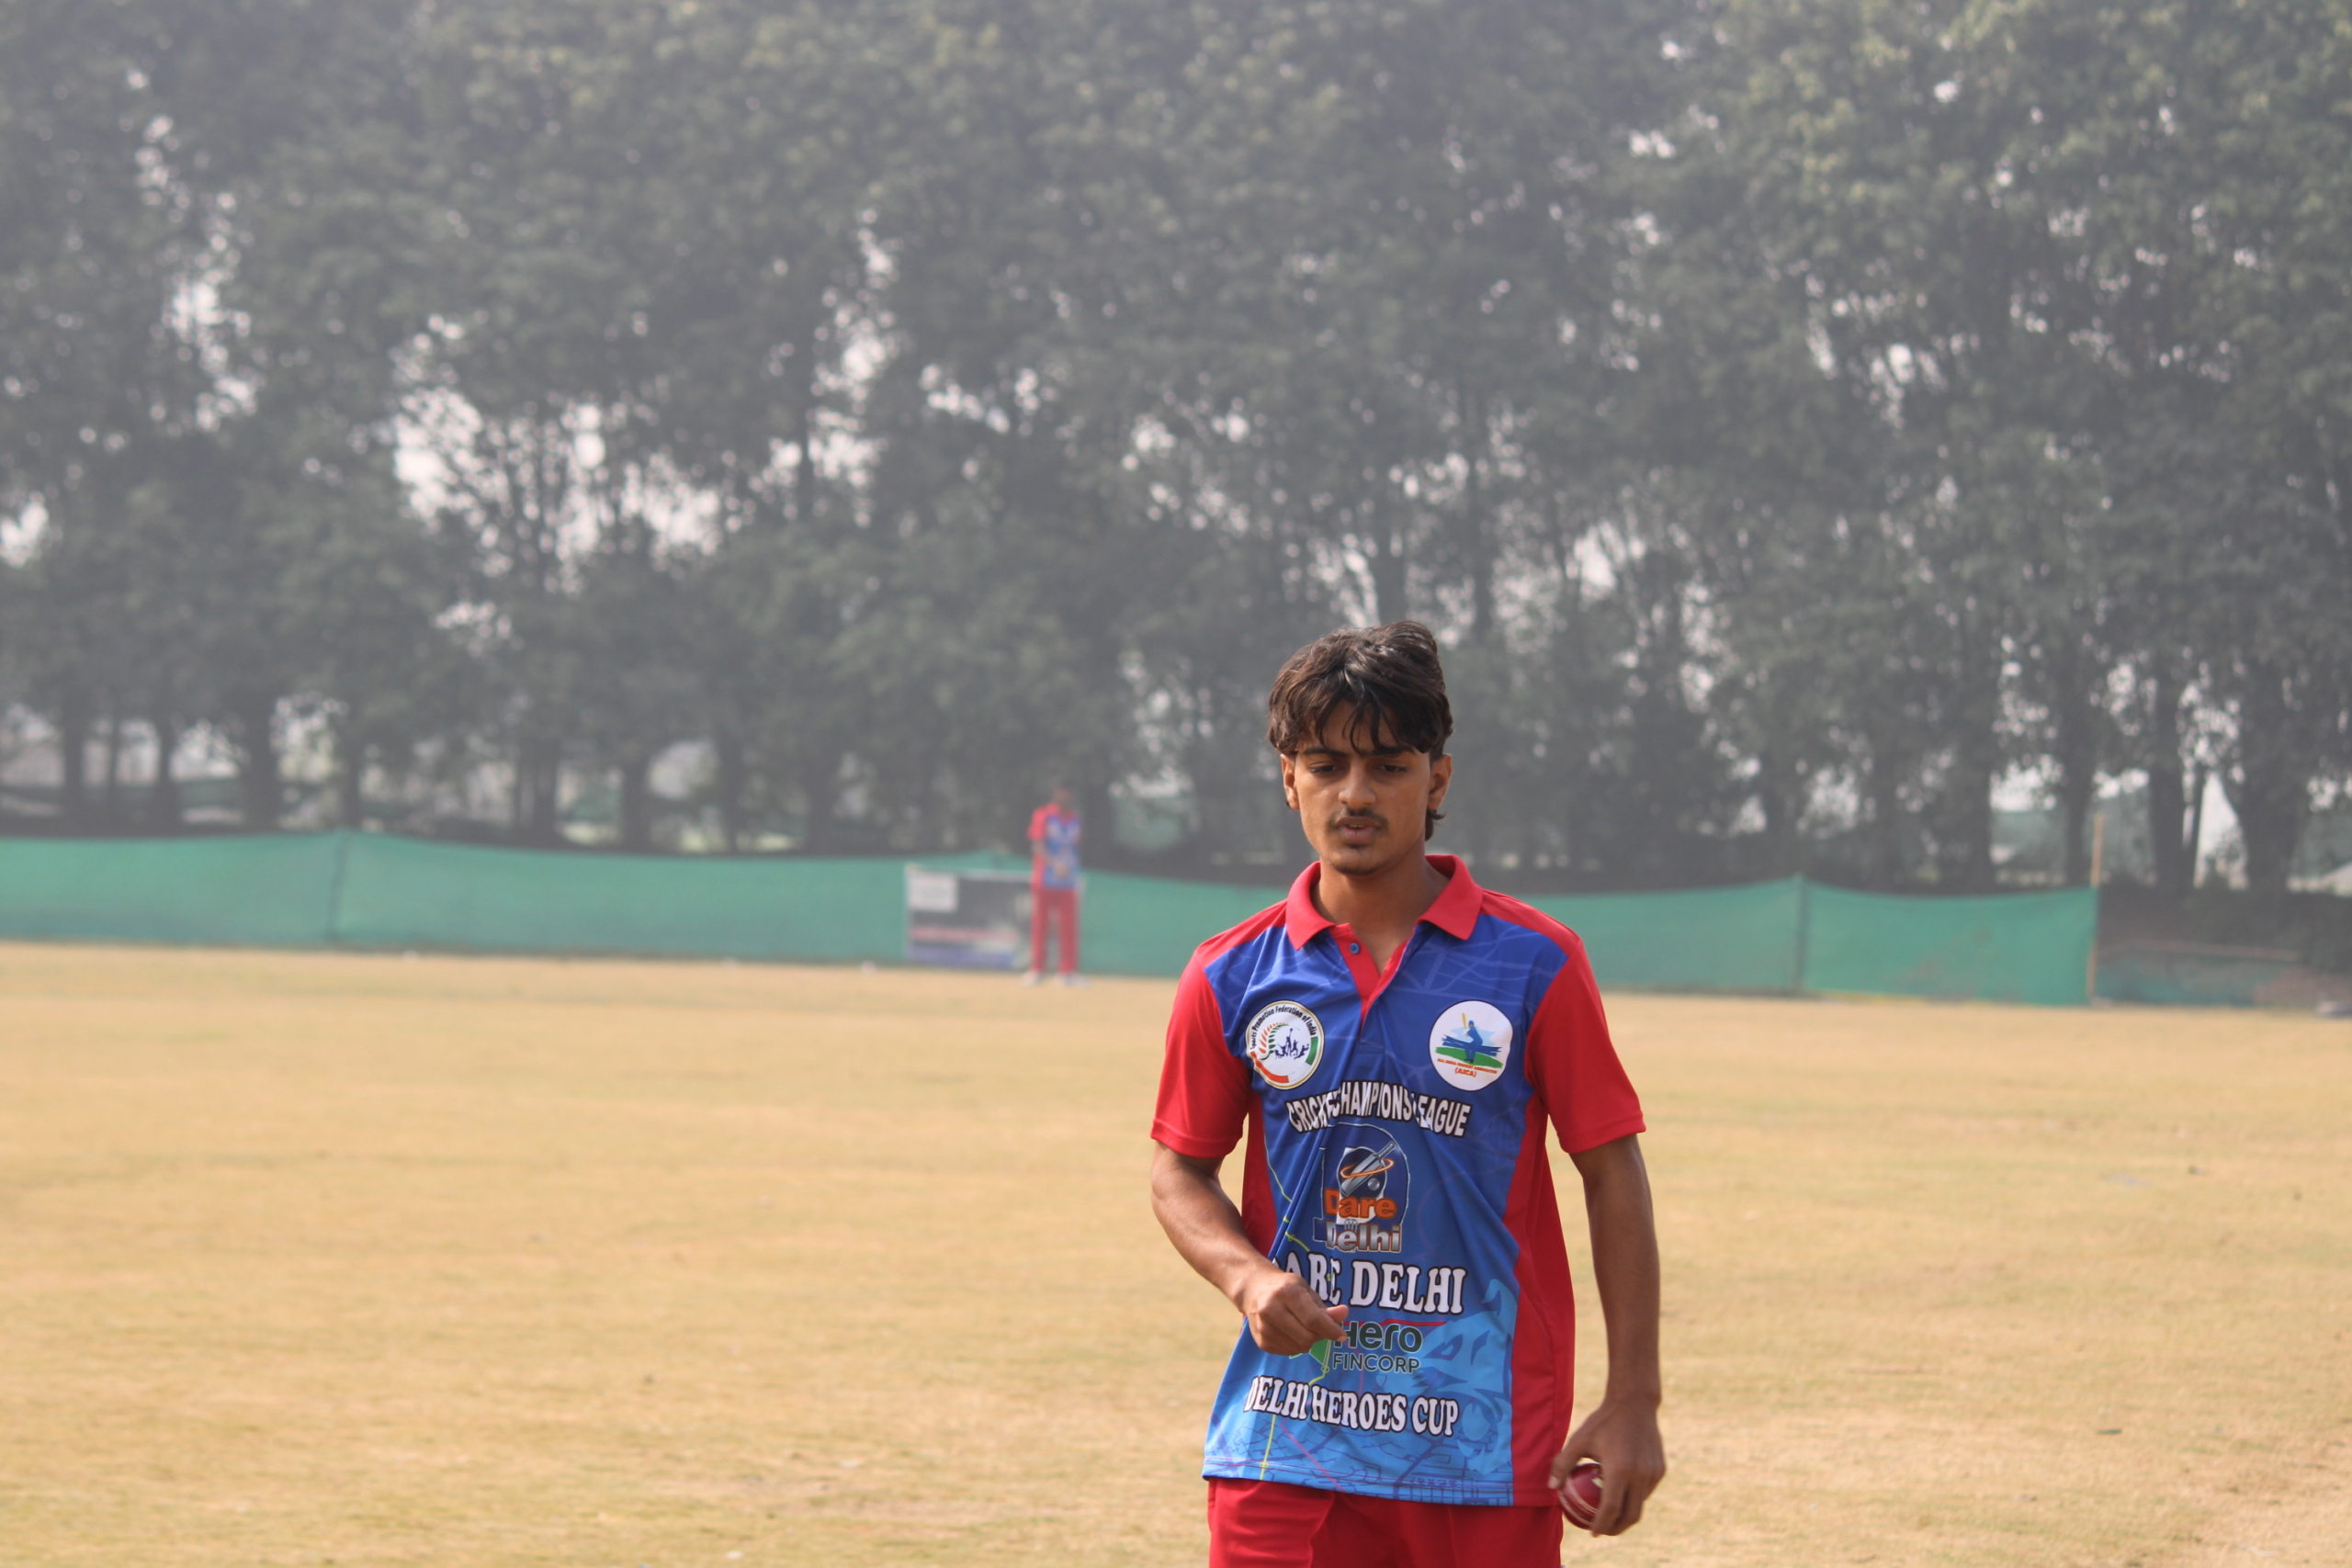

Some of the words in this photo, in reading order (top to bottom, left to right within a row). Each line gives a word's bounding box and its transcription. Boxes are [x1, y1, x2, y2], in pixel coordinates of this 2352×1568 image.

[1251, 1009, 1275, 1032] Promotion
[1275, 1005, 1303, 1019] Federation
[1301, 1015, 1311, 1023] of
[1306, 1019, 1317, 1036] India
[1323, 1188, 1397, 1220] Dare
[1325, 1220, 1402, 1252] Delhi
[1272, 1251, 1341, 1306] ARE
[1349, 1258, 1468, 1315] DELHI
[1333, 1320, 1423, 1354] Hero
[1332, 1351, 1421, 1374] FINCORP
[1310, 1385, 1408, 1433] HEROES
[1411, 1396, 1460, 1438] CUP
